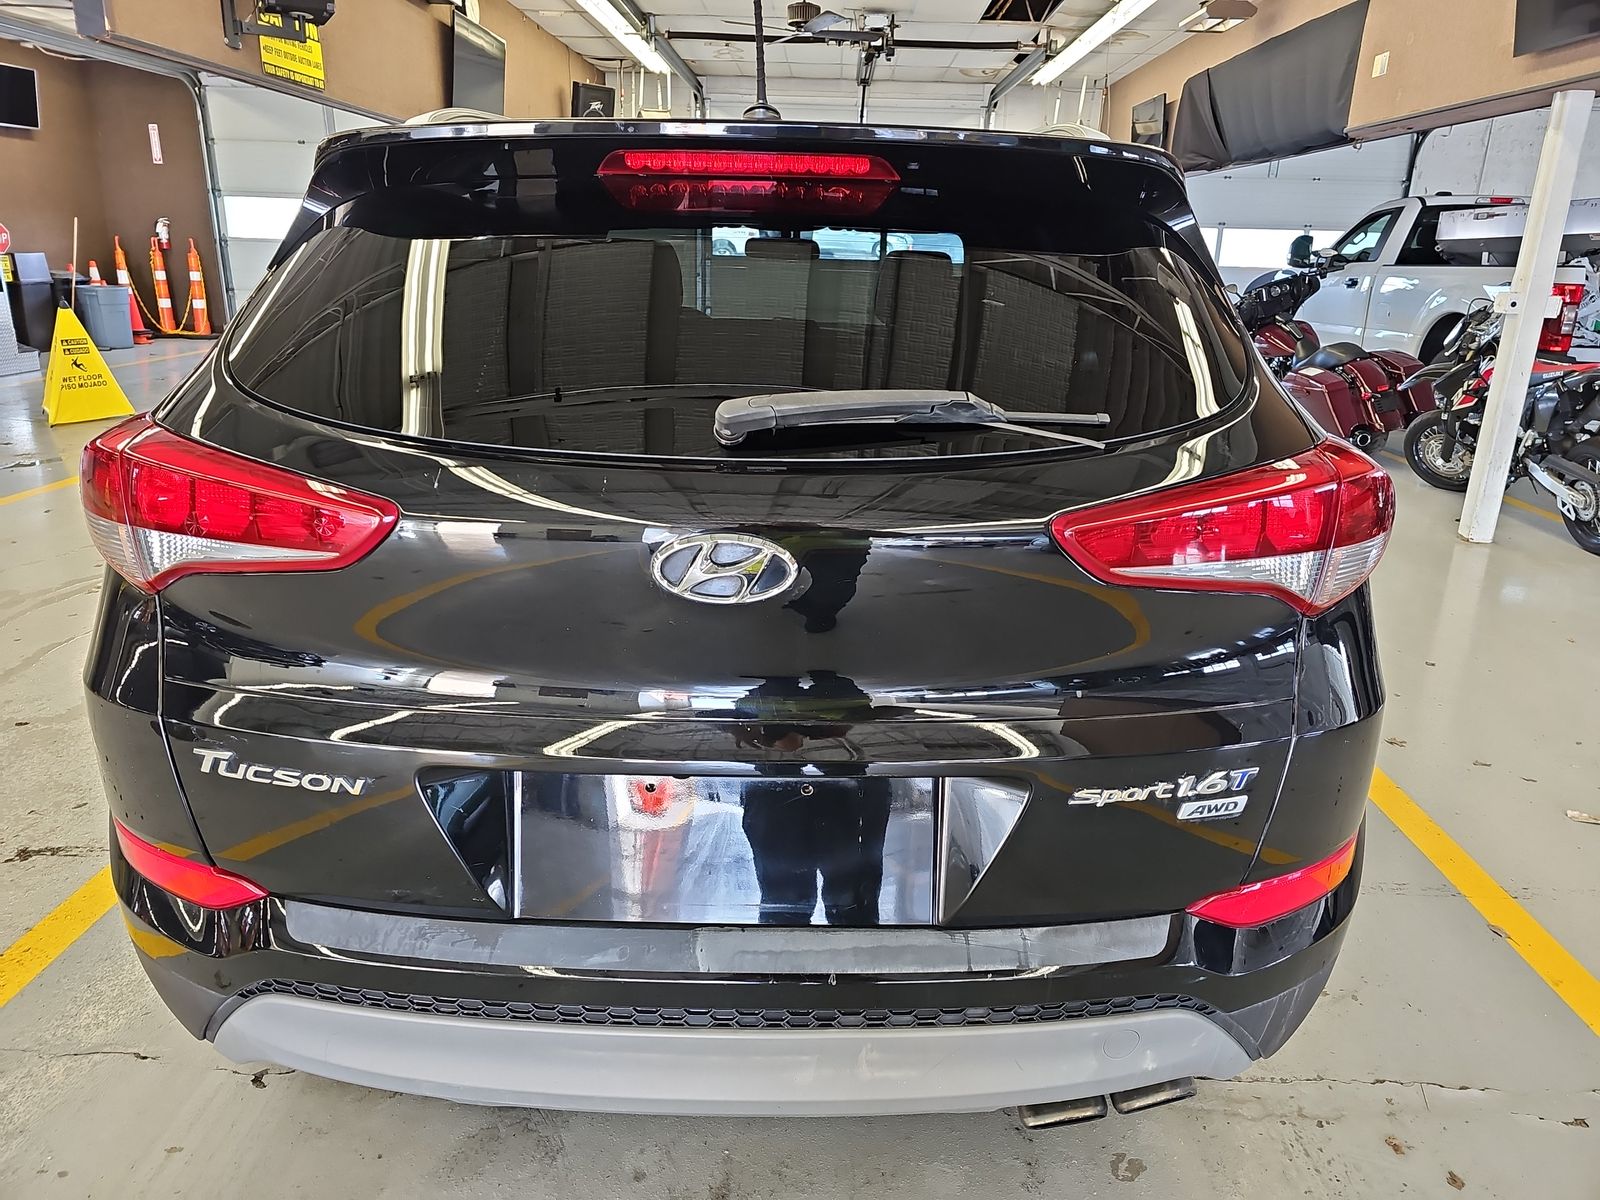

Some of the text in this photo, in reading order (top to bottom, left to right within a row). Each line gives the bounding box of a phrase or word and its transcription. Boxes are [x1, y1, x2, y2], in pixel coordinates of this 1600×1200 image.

[78, 373, 103, 381] FLOOR
[78, 380, 107, 388] MOJADO
[1187, 801, 1240, 818] AWD
